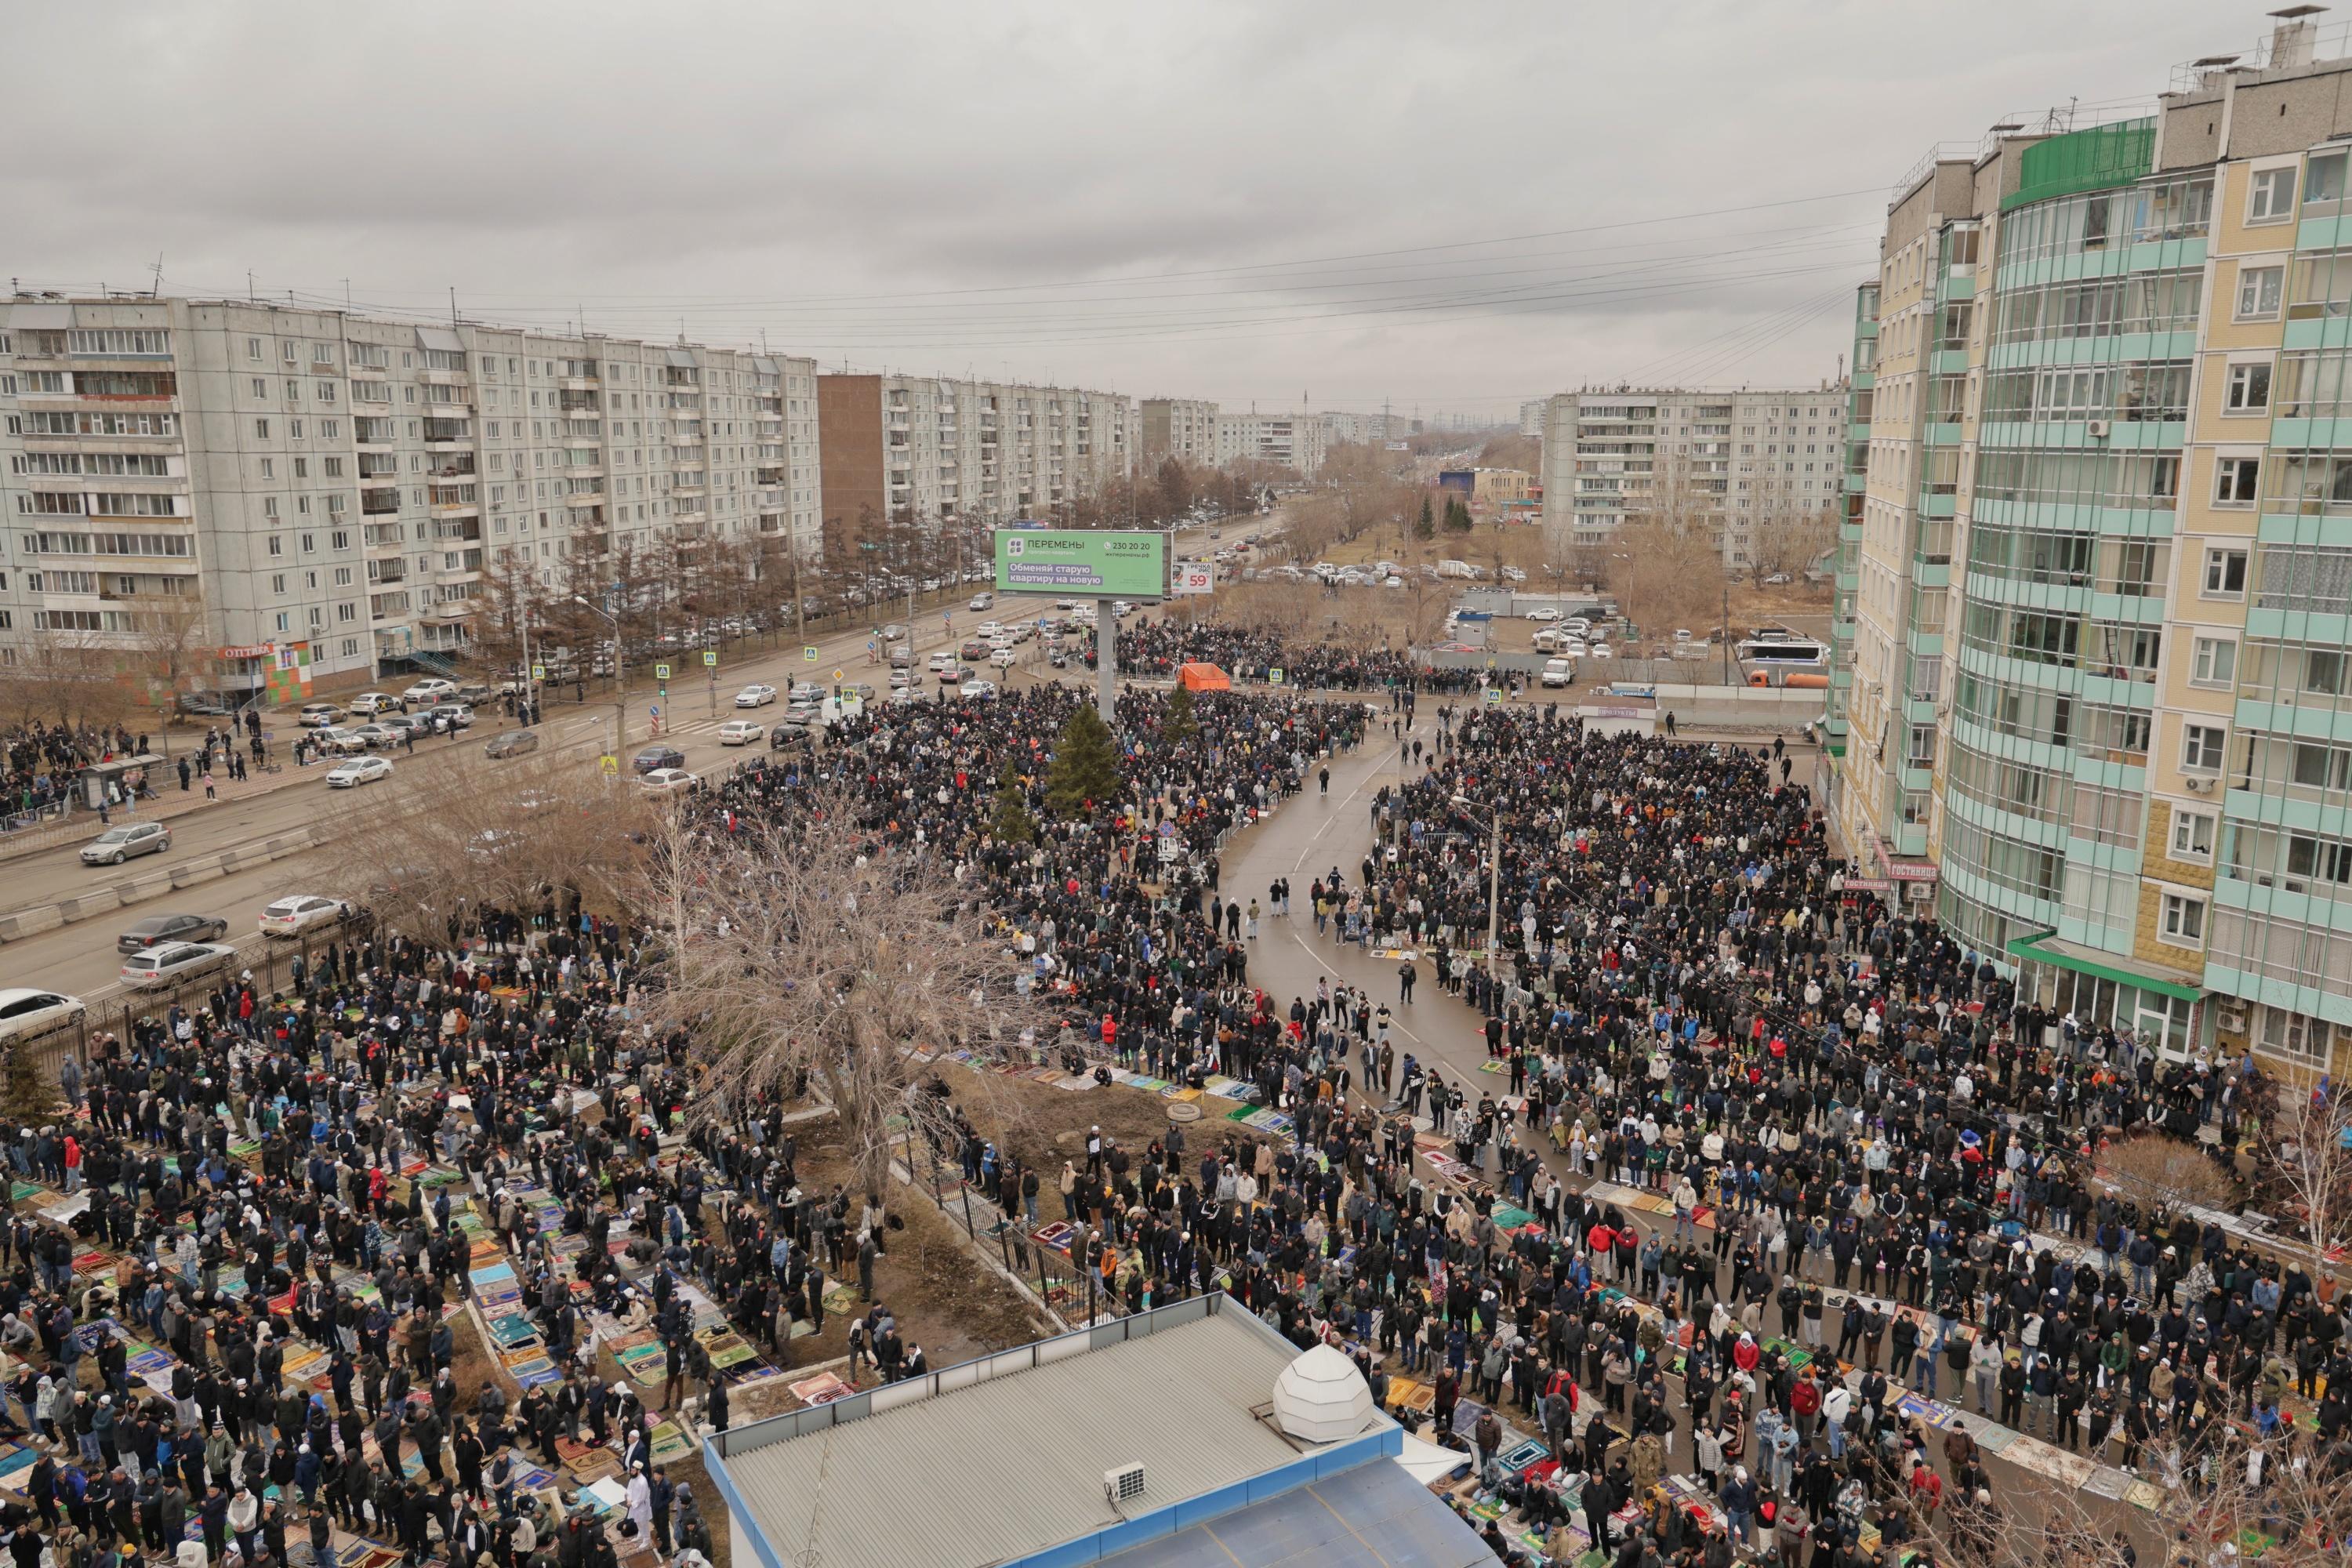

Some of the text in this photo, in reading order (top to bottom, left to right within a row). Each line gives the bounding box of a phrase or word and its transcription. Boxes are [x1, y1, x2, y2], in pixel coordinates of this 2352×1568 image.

[1028, 539, 1084, 549] ПЕРЕМЕНЫ
[1010, 563, 1091, 575] Обменяй старую
[1010, 574, 1054, 584] квартиру
[1070, 577, 1101, 586] новую
[1189, 575, 1207, 586] 59
[225, 645, 270, 658] ОПТИКА
[1599, 708, 1637, 717] ПРОДУКТЫ
